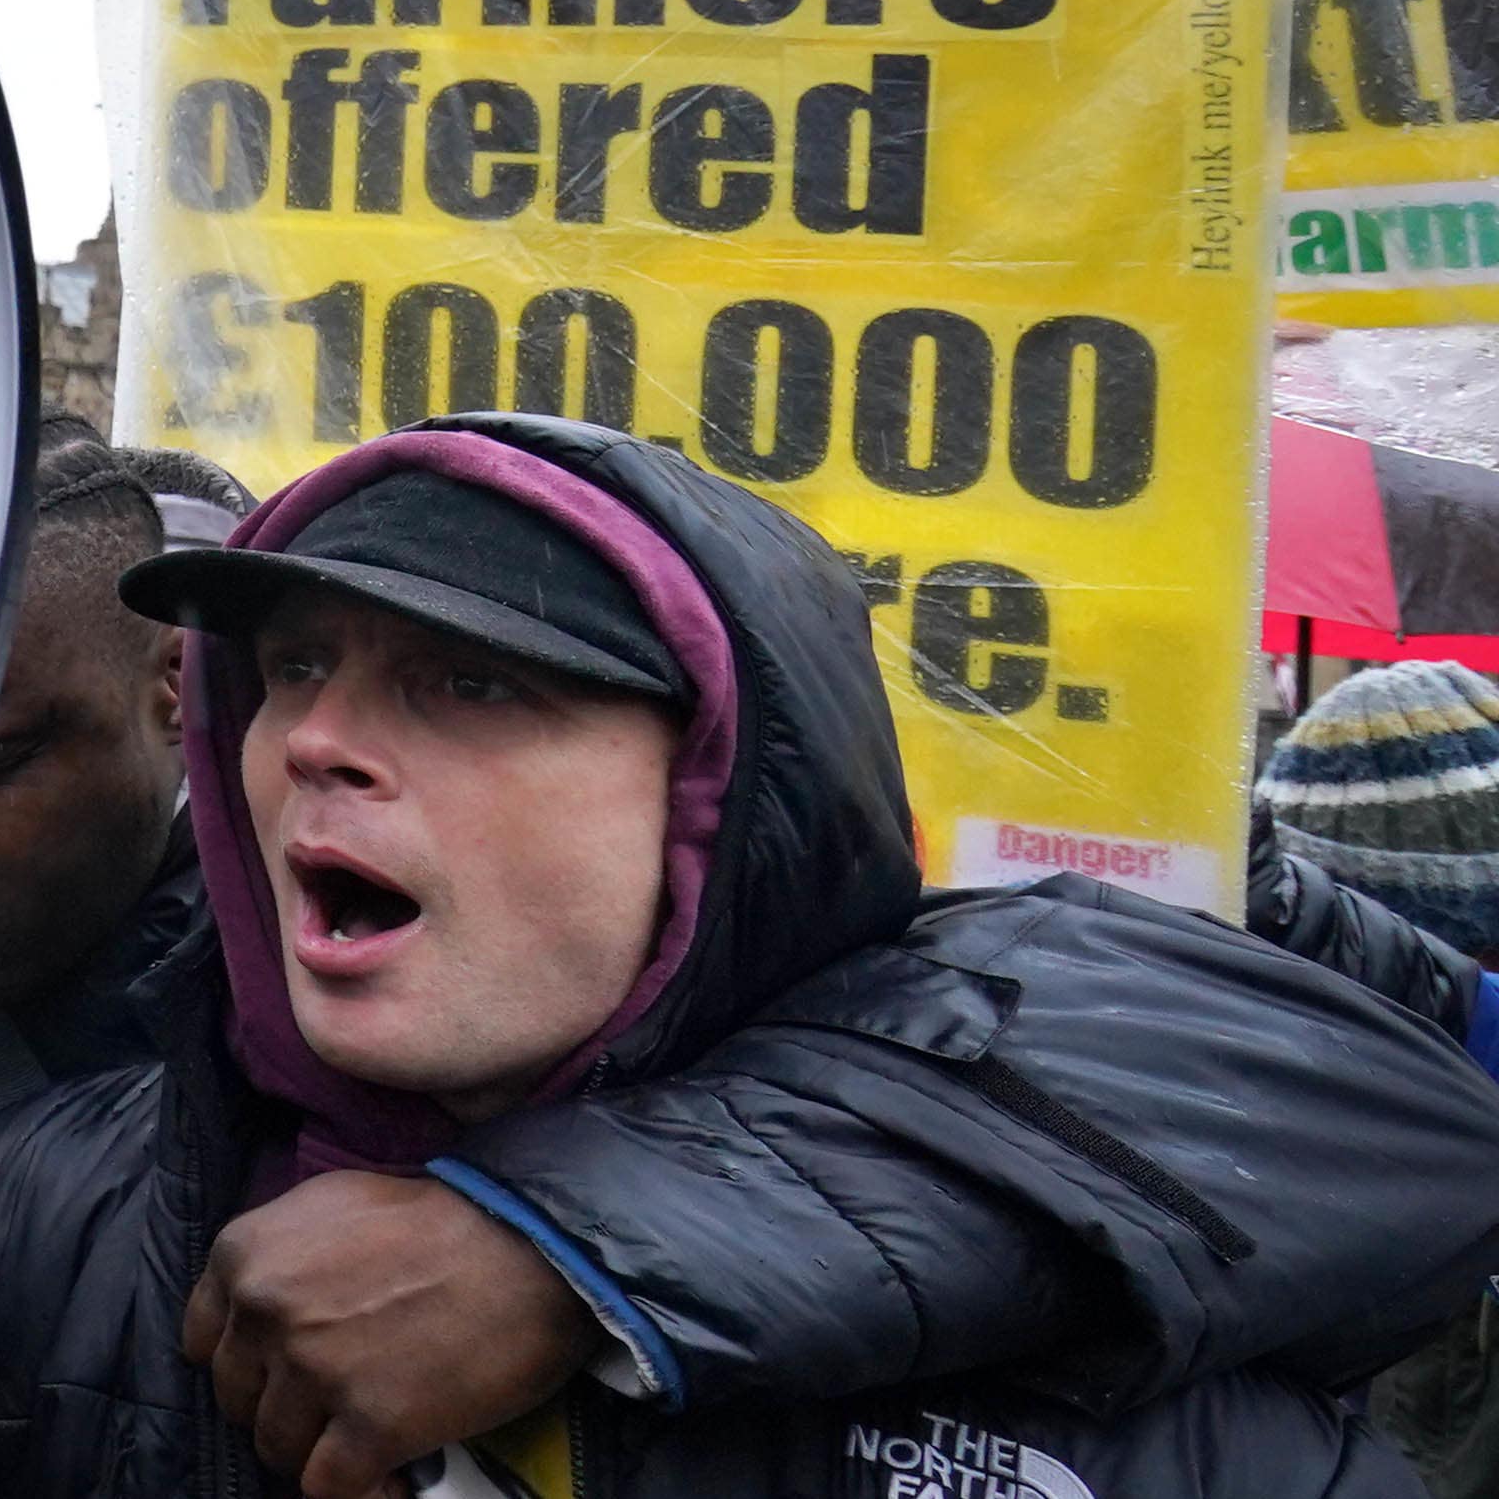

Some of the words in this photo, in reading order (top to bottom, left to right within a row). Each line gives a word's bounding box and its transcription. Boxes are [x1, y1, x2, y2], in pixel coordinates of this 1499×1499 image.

[167, 48, 929, 235] offered
[847, 1423, 1017, 1499] NORTH
[922, 1411, 1018, 1479] THE
